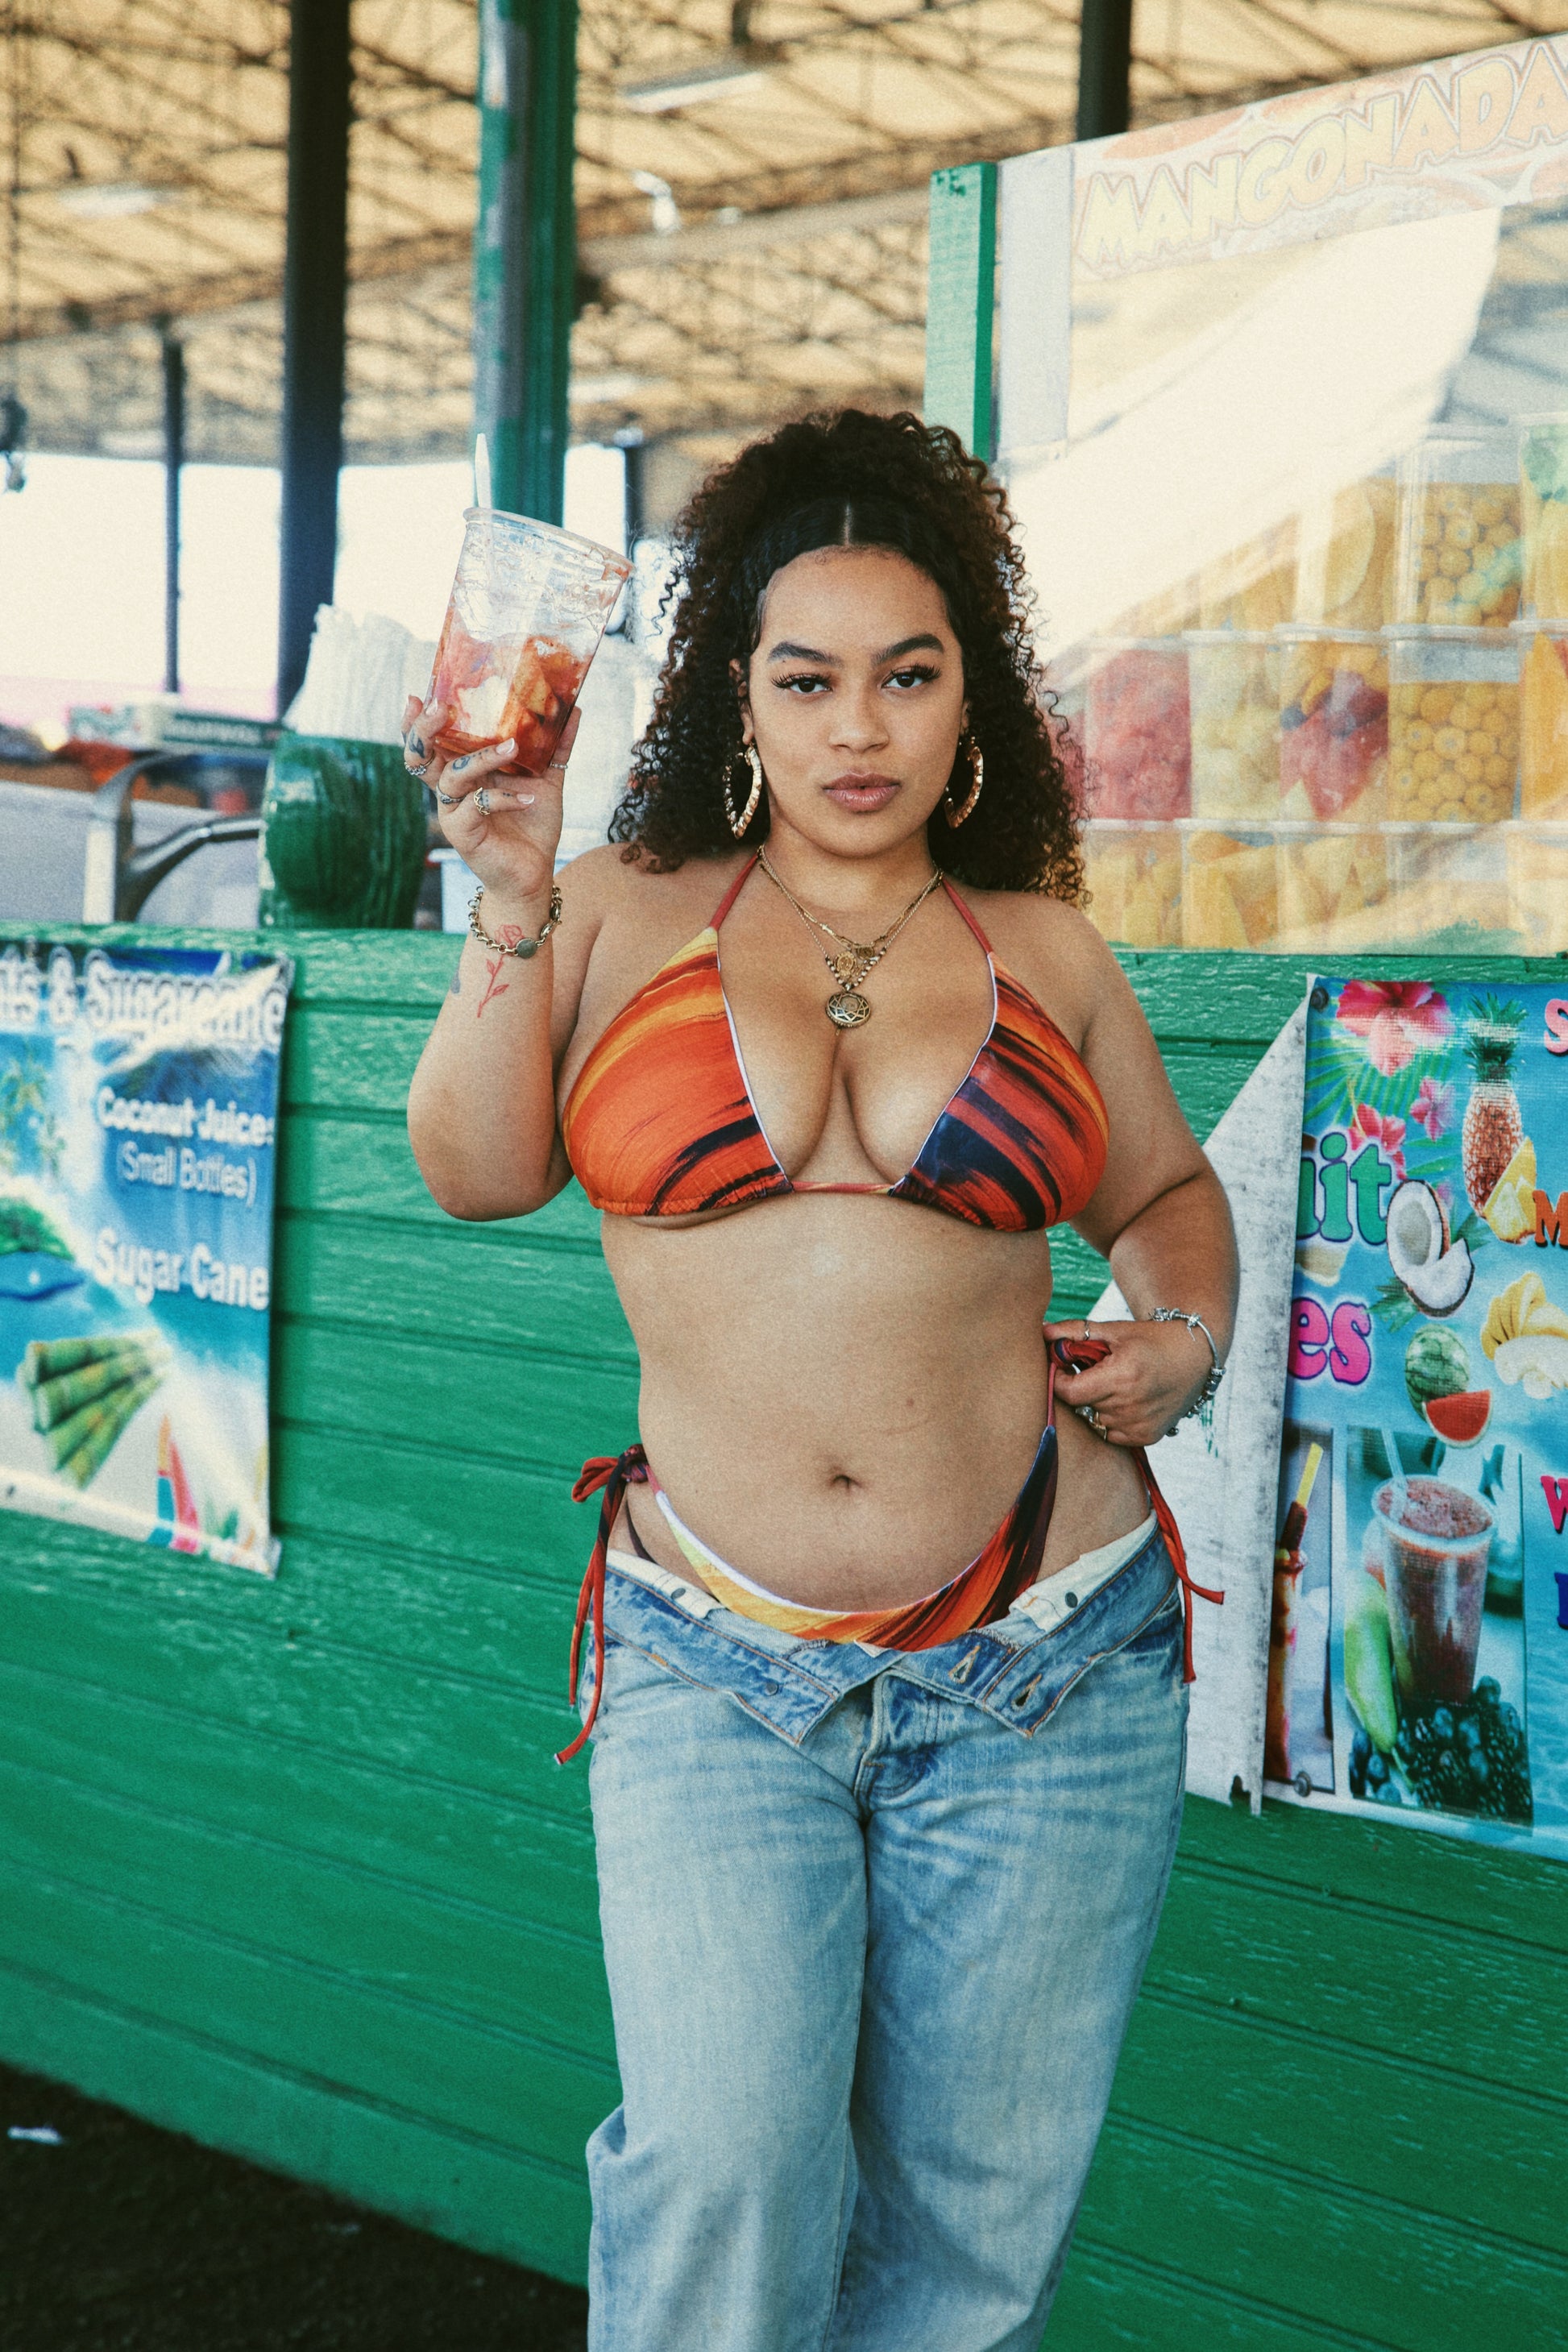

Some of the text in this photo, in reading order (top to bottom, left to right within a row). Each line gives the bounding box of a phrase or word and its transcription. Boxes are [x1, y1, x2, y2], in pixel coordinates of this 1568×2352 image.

[98, 1086, 194, 1138] Coconut
[180, 1147, 257, 1207] Bottles)
[93, 1228, 270, 1310] Sugar Cane
